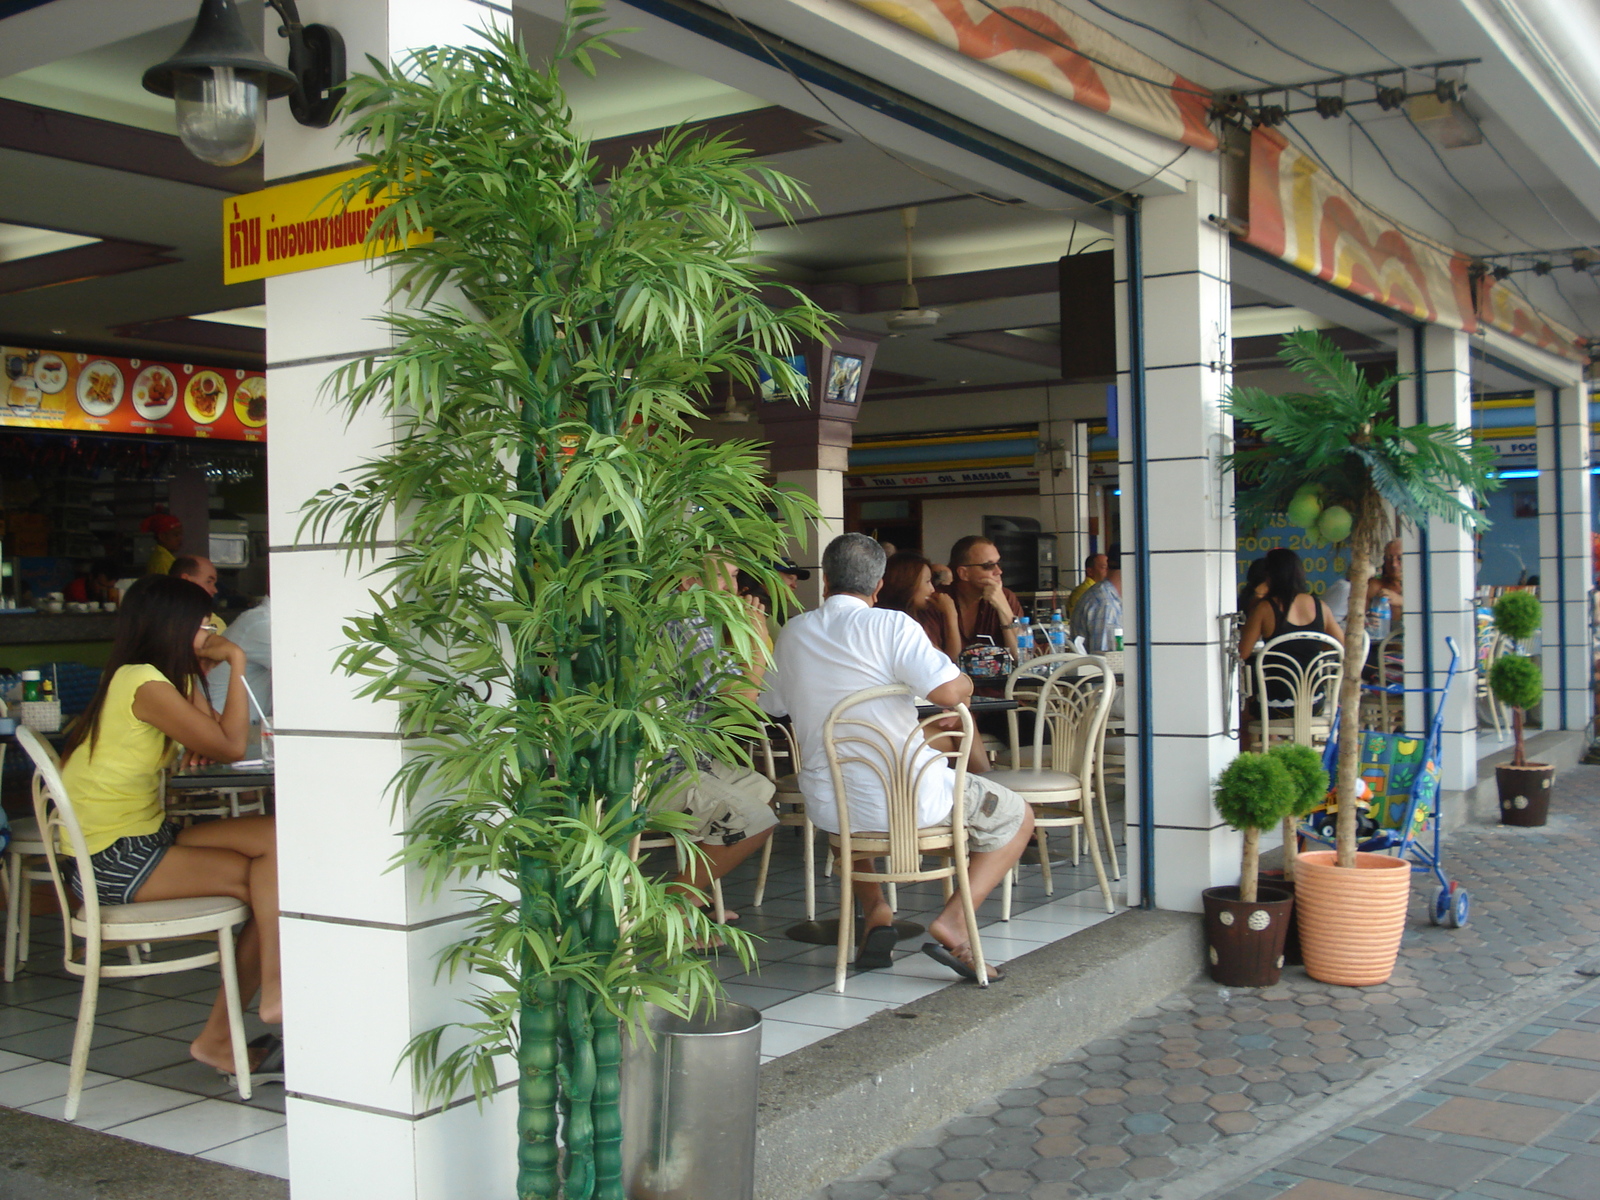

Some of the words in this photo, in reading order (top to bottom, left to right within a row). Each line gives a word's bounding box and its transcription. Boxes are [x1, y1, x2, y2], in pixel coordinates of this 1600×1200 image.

[872, 478, 897, 486] THAI
[901, 476, 929, 485] FOOT
[938, 475, 956, 483] OIL
[961, 471, 1012, 482] MASSAGE
[1236, 536, 1282, 551] FOOT
